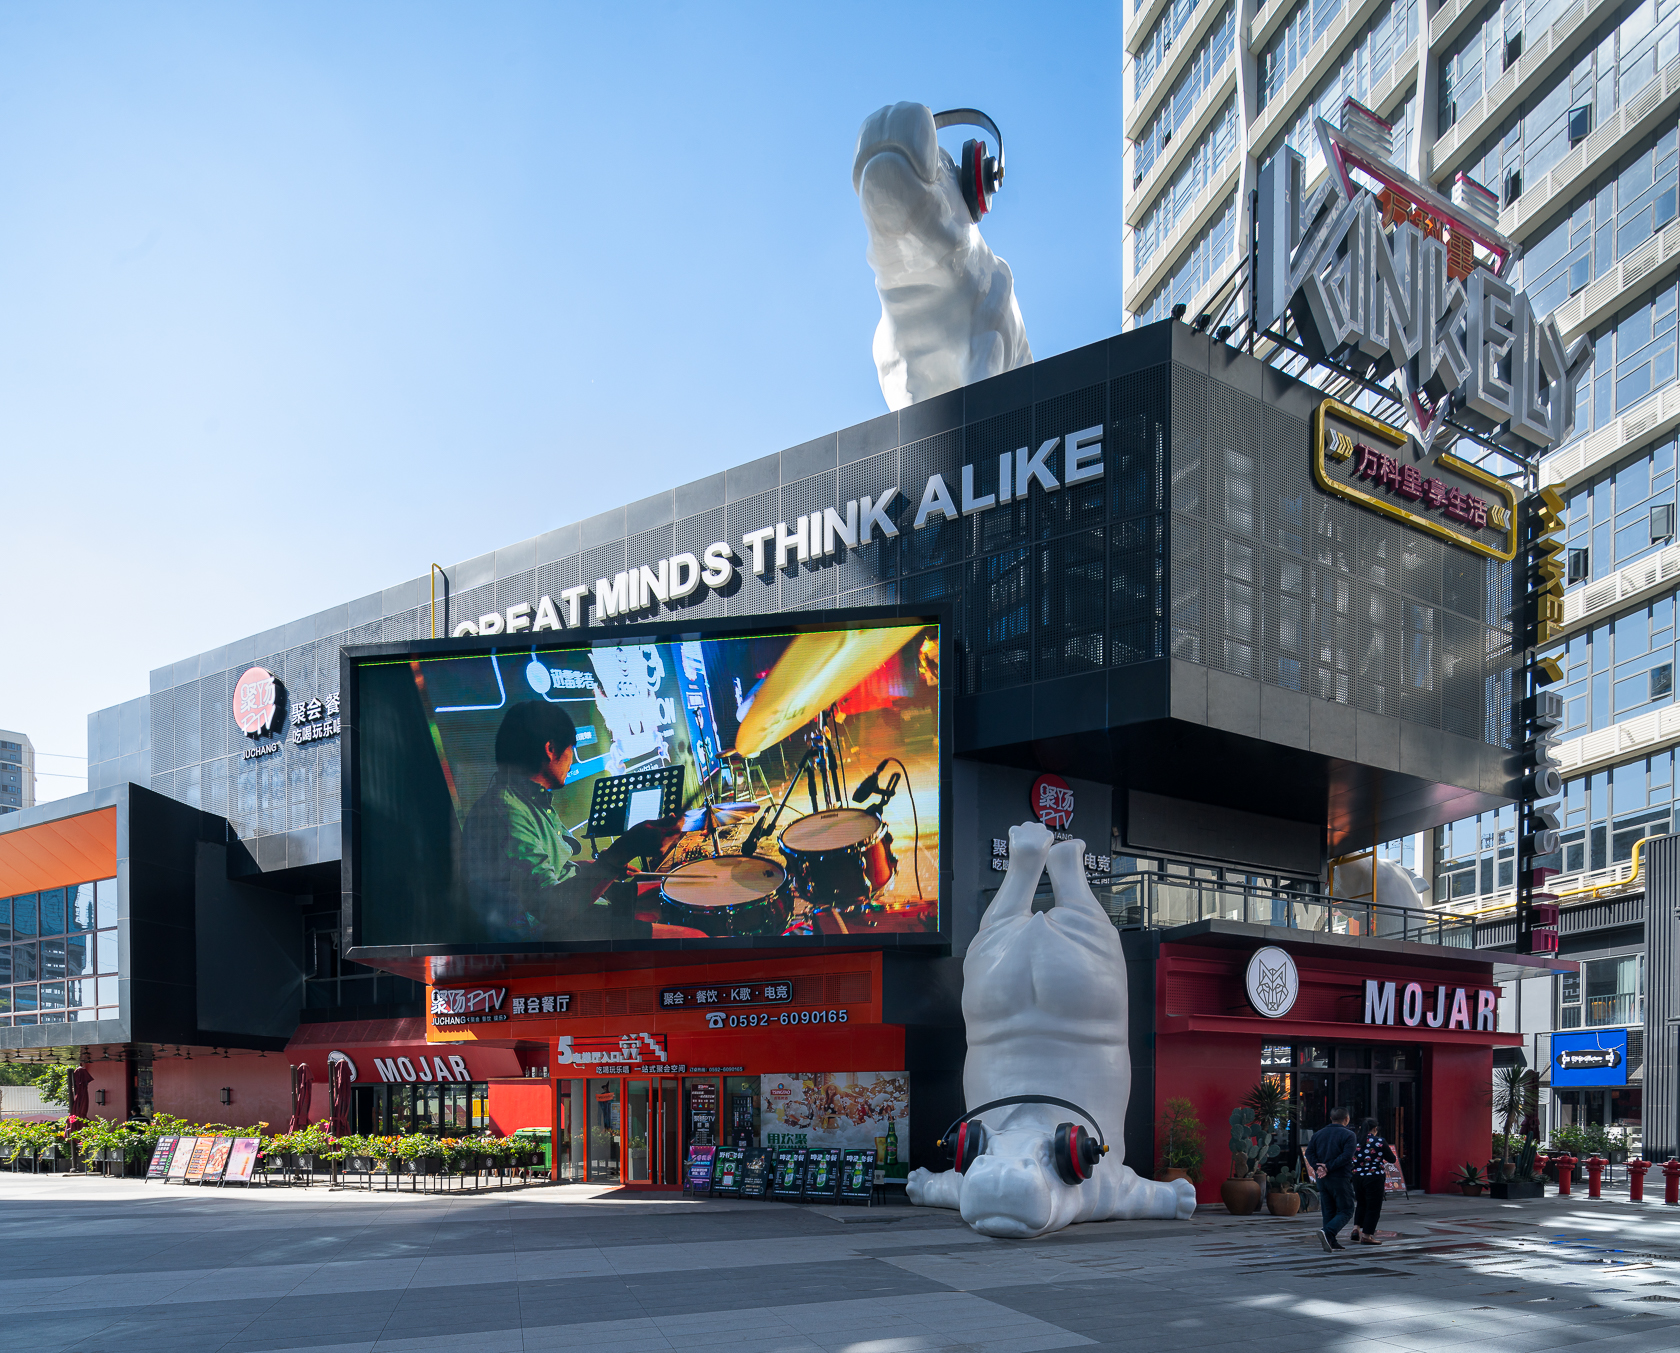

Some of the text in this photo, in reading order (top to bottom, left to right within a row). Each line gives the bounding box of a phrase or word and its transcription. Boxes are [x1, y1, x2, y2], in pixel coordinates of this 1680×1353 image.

[595, 540, 735, 620] MINDS
[742, 486, 900, 576] THINK
[913, 423, 1105, 530] ALIKE
[241, 742, 277, 760] JUCHANG
[1084, 853, 1111, 872] 电竞
[512, 994, 571, 1014] 聚会餐厅
[1362, 978, 1495, 1031] MOJAR
[431, 1016, 466, 1026] JUCHANG
[729, 1009, 848, 1028] 0592-6090165
[374, 1055, 472, 1082] MOJAR
[767, 1133, 808, 1145] 用欢聚
